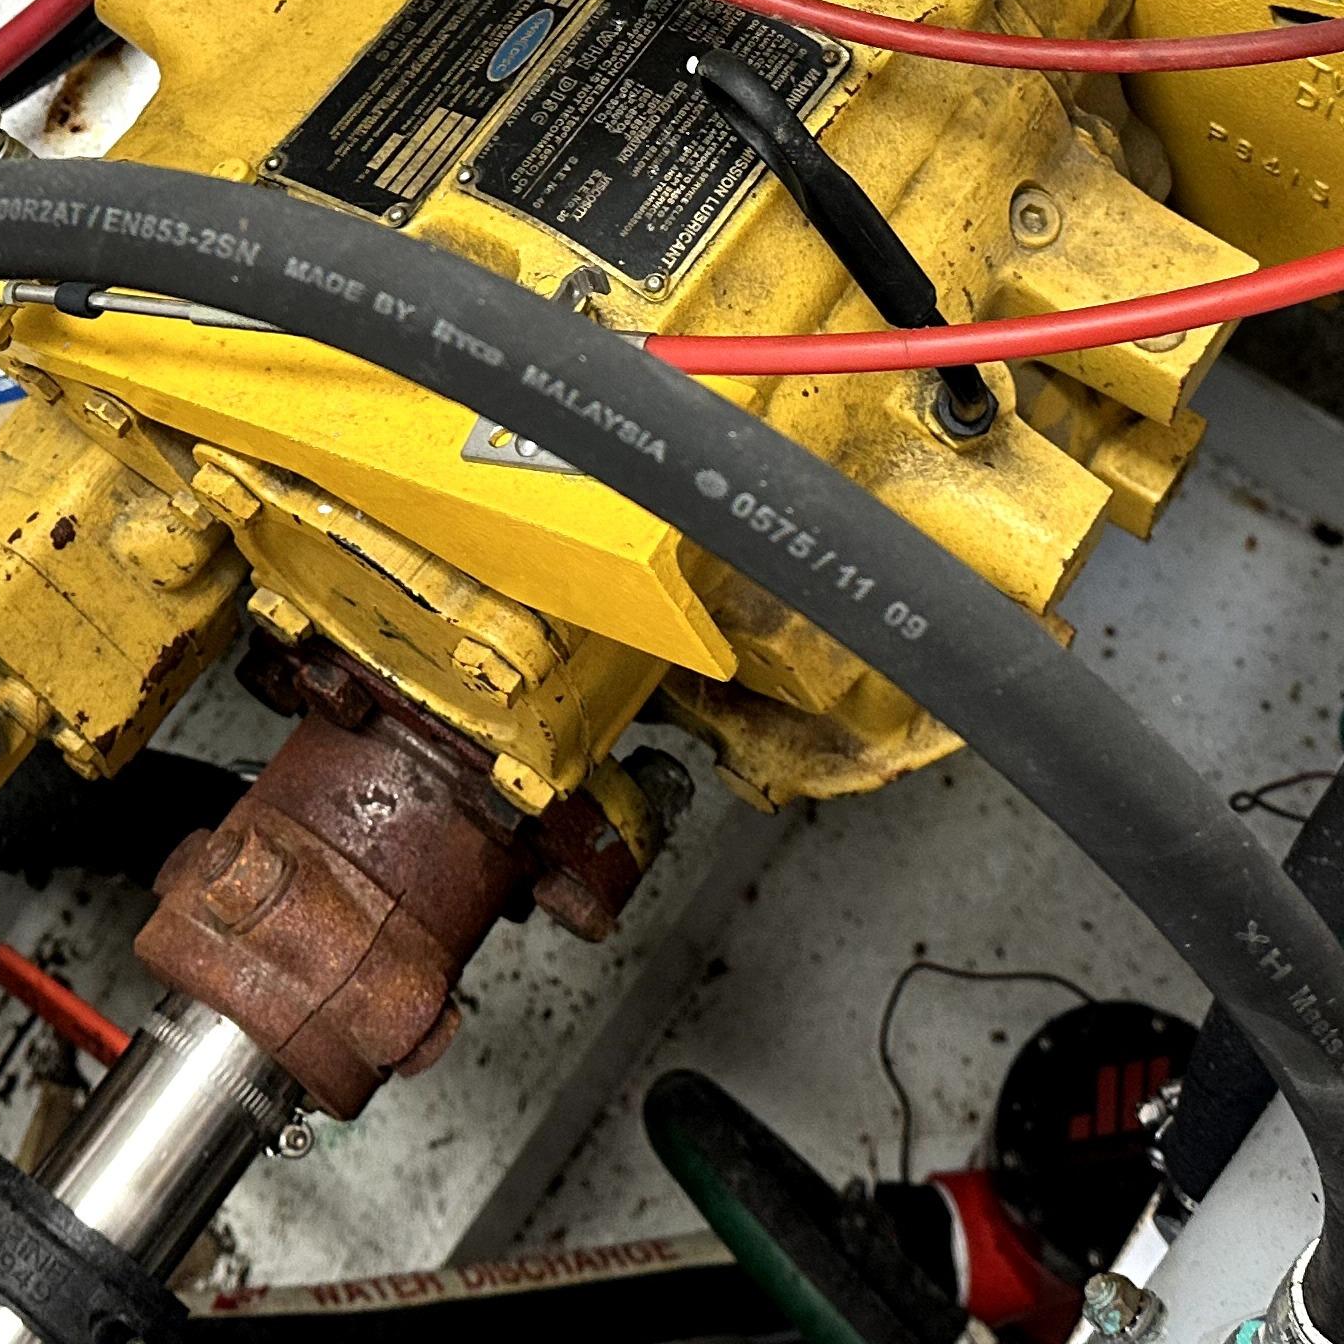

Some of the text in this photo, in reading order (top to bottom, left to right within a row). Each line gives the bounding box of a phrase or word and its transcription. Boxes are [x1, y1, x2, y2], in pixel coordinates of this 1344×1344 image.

[605, 19, 658, 77] OPERATION
[528, 74, 579, 127] DISC
[570, 83, 593, 106] NOT
[575, 76, 611, 114] BELOW
[779, 66, 824, 111] MARIN
[615, 113, 662, 164] OPERATION
[510, 176, 530, 195] OR
[570, 173, 613, 222] VISCOSITY
[710, 145, 760, 198] MISSION
[656, 194, 721, 269] LUBRICANT
[282, 254, 368, 305] MADE
[372, 289, 417, 324] BY
[519, 362, 670, 464] MALAYSIA
[306, 1238, 680, 1308] WATER DISCHARGE
